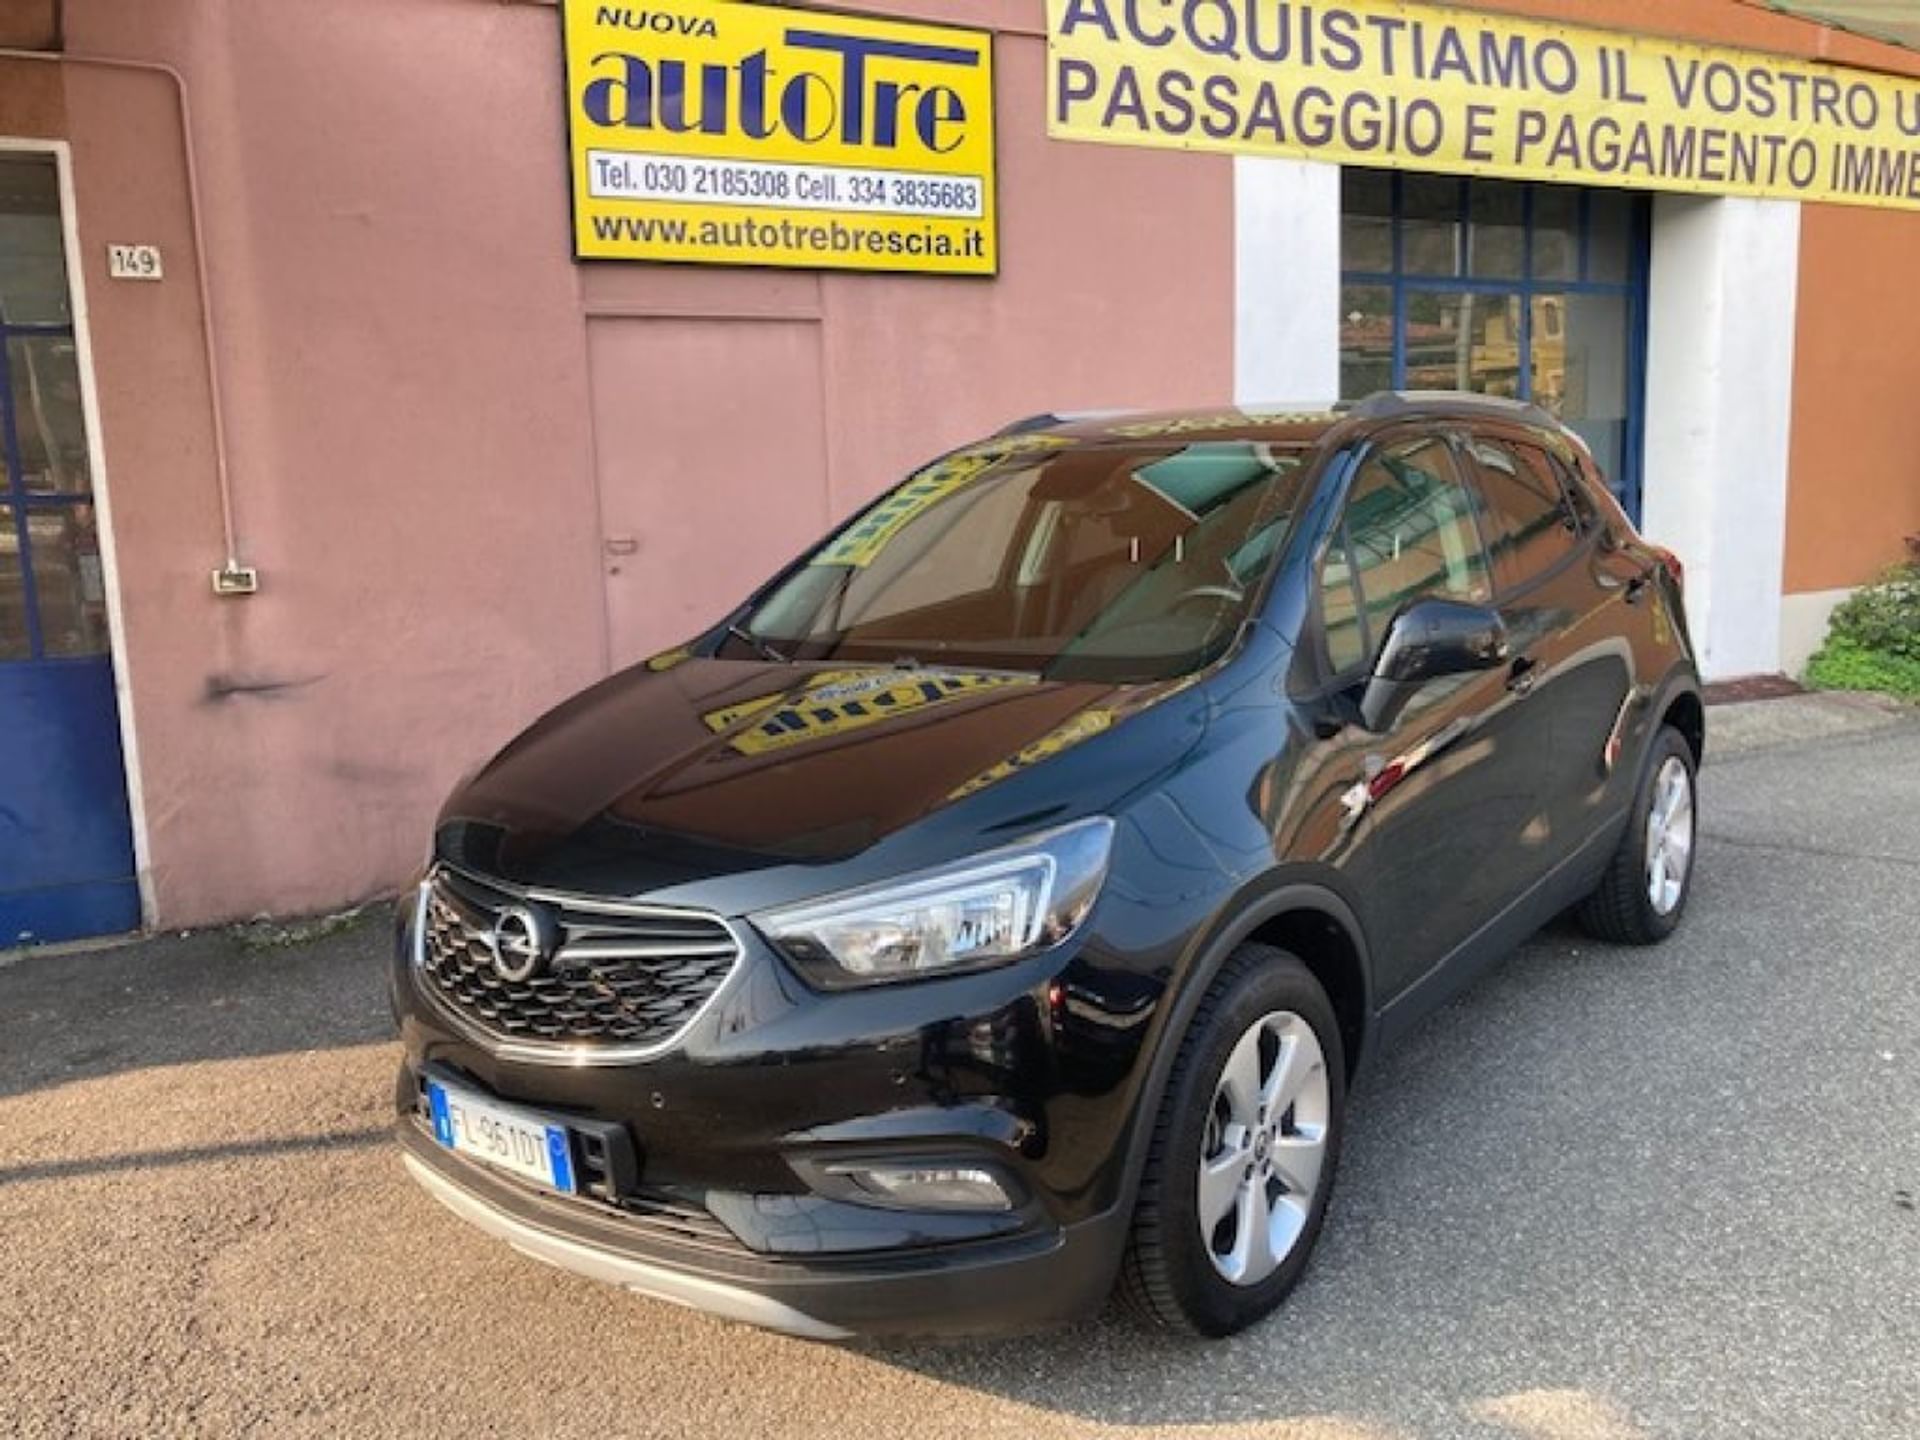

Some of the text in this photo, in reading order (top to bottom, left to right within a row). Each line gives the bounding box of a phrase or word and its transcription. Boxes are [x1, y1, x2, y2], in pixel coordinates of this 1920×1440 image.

[596, 6, 718, 38] NUOVA
[1060, 0, 1577, 95] ACQUISTIAMO
[1598, 46, 1647, 104] IL
[1664, 55, 1879, 130] VOSTRO
[1056, 59, 1443, 157] PASSAGGIO
[1462, 105, 1496, 161] E
[1514, 110, 1817, 189] PAGAMENTO
[597, 159, 977, 211] Tel. 030 2185308 Cell. 334 3835683
[592, 216, 985, 257] www.autotrebrescia.it
[115, 249, 155, 274] 149
